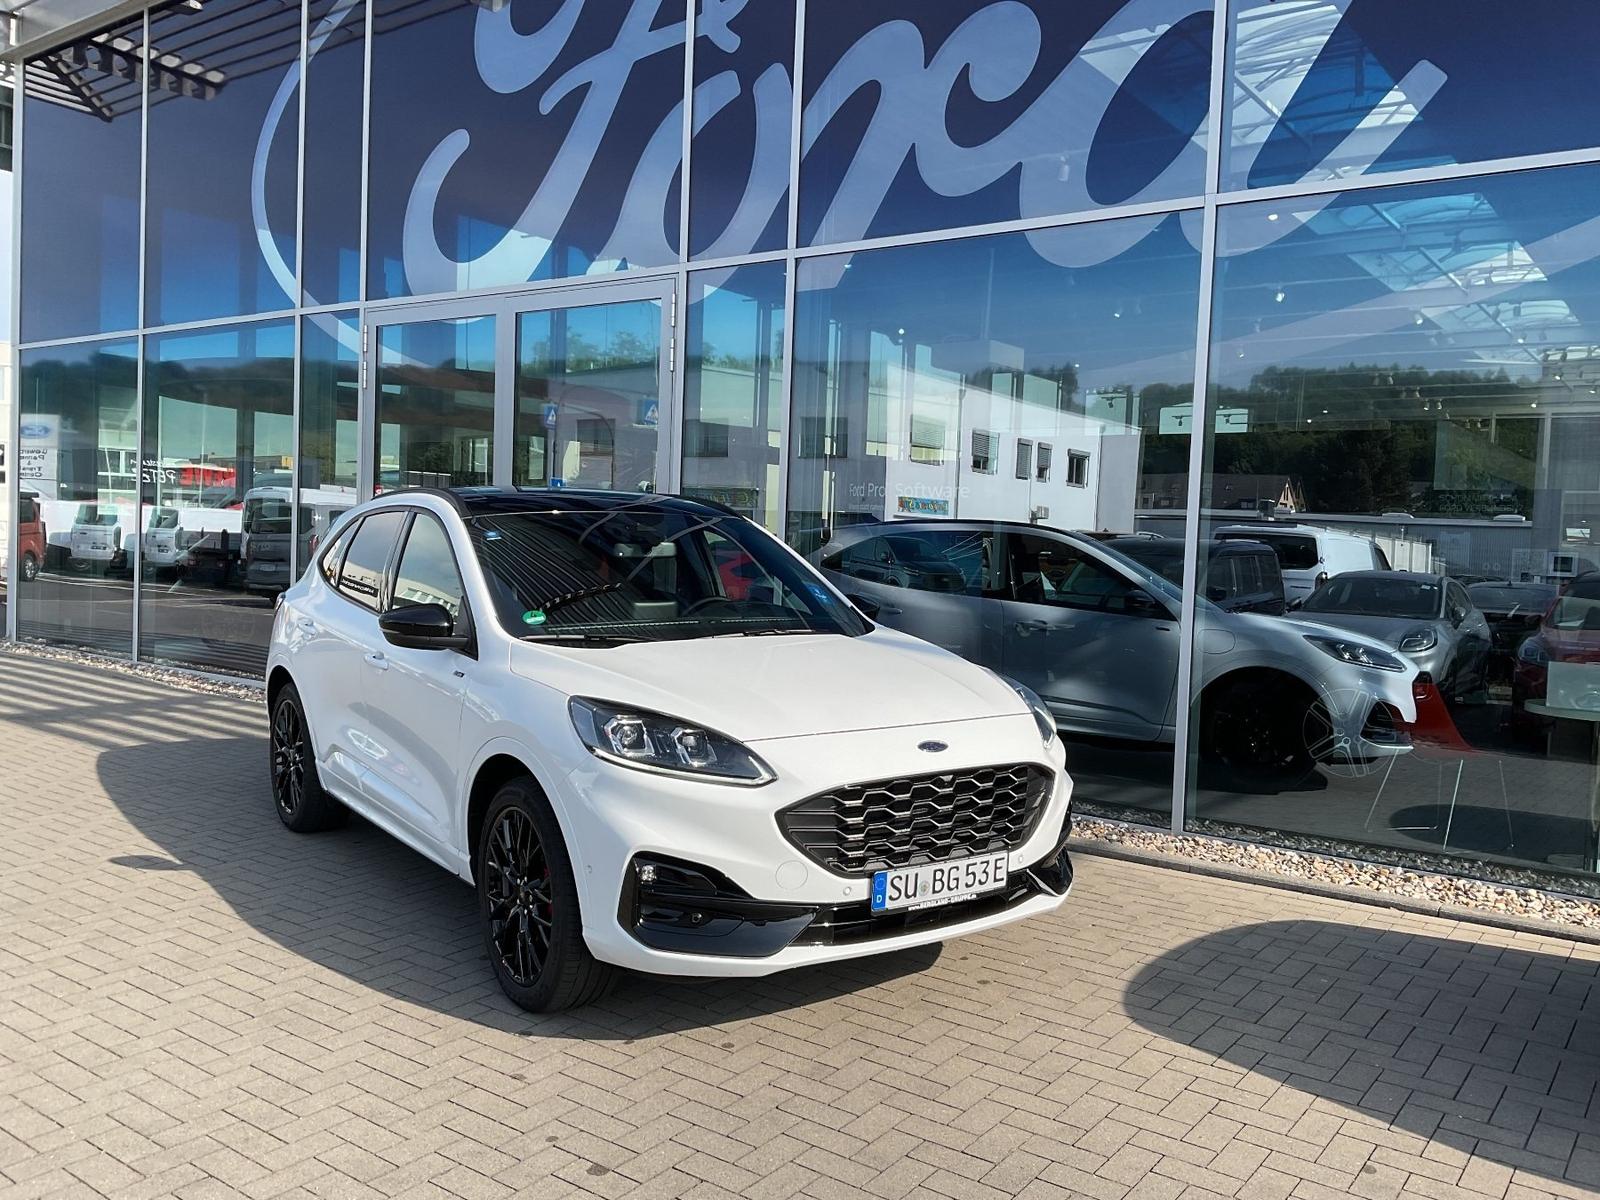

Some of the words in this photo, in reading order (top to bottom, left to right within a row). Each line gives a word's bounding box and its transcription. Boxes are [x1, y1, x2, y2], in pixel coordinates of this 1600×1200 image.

[403, 0, 1448, 318] Ford
[849, 483, 865, 497] Ford
[867, 483, 889, 498] Pro
[895, 482, 970, 498] Software
[888, 872, 919, 901] SU
[932, 865, 960, 894] BG
[965, 857, 1005, 889] 53E
[876, 895, 882, 903] D
